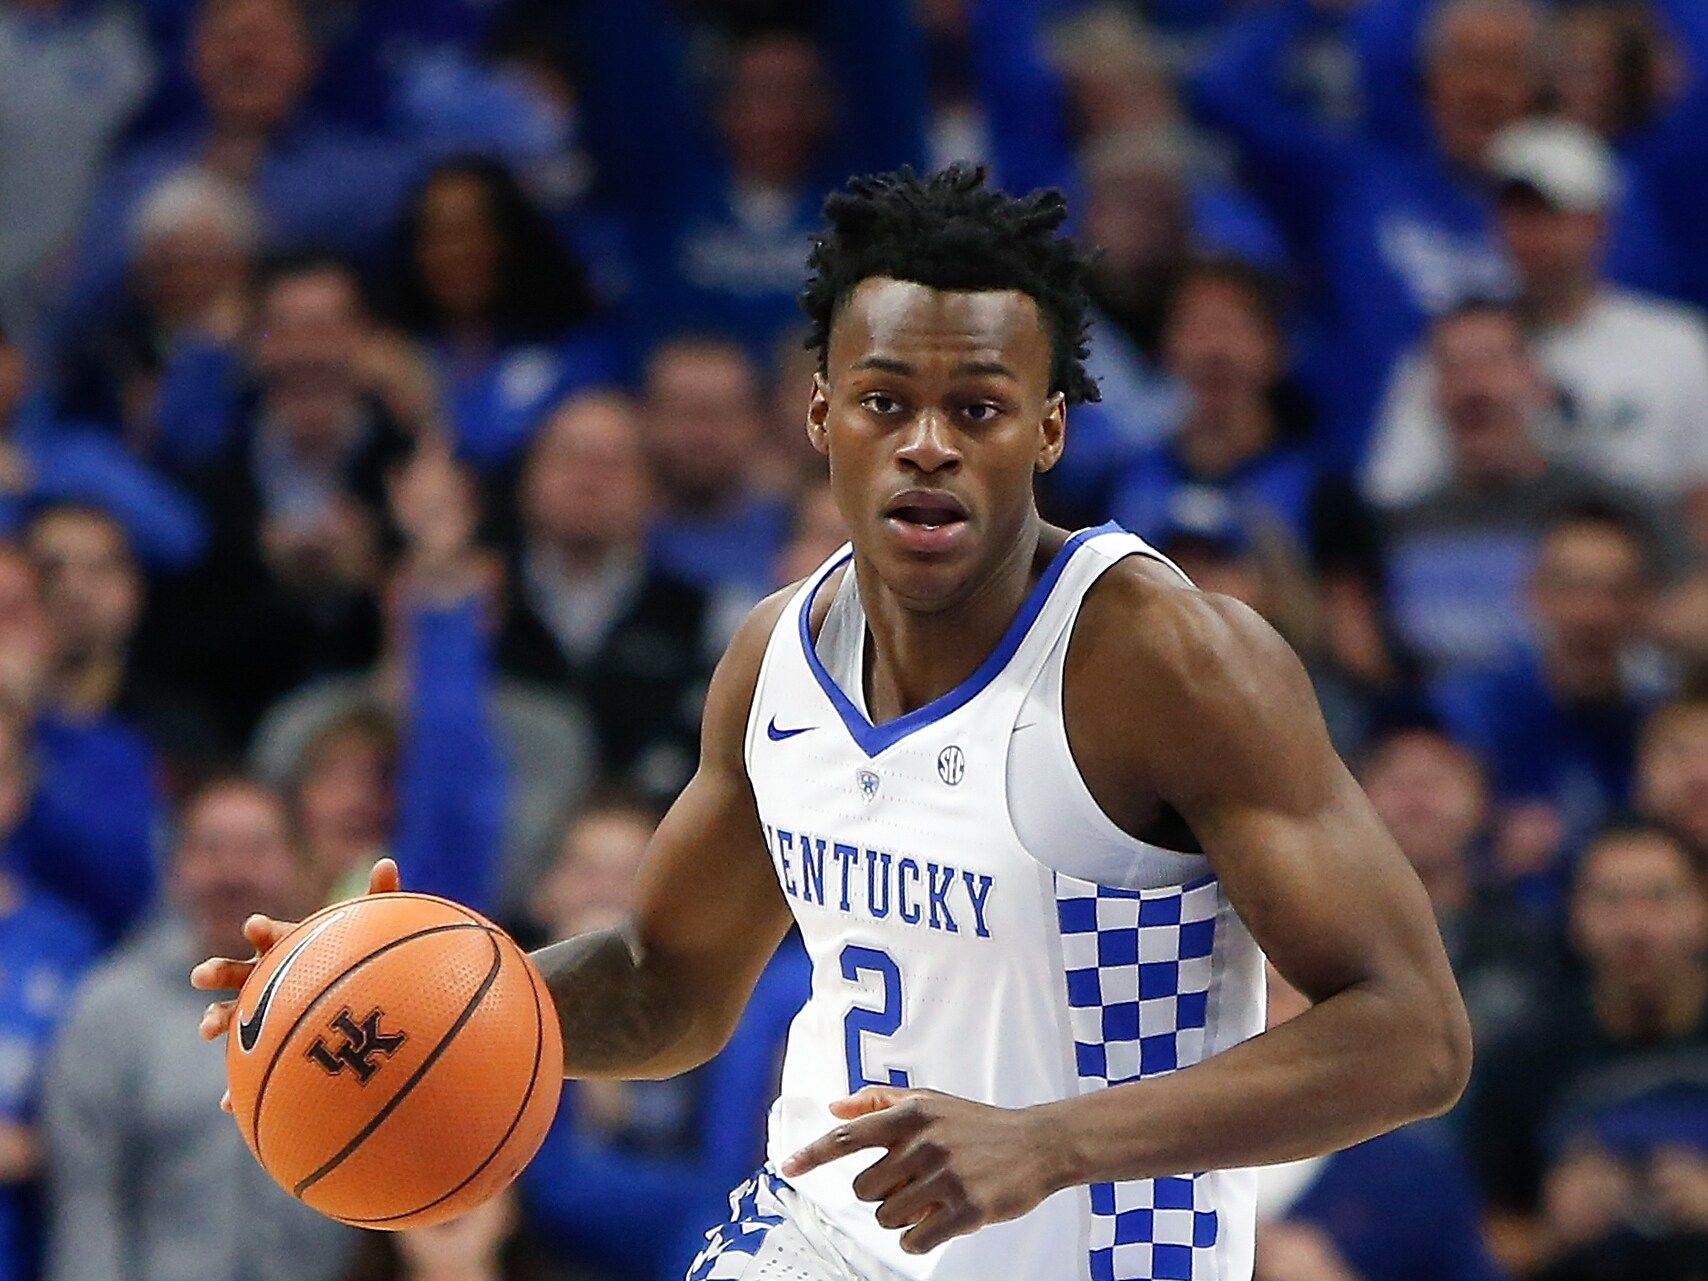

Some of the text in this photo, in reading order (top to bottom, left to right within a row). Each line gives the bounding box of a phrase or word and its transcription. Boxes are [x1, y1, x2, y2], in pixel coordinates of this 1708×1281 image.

[938, 746, 964, 785] SEC
[766, 825, 993, 938] ENTUCKY
[303, 1005, 407, 1087] UK
[839, 944, 909, 1096] 2
